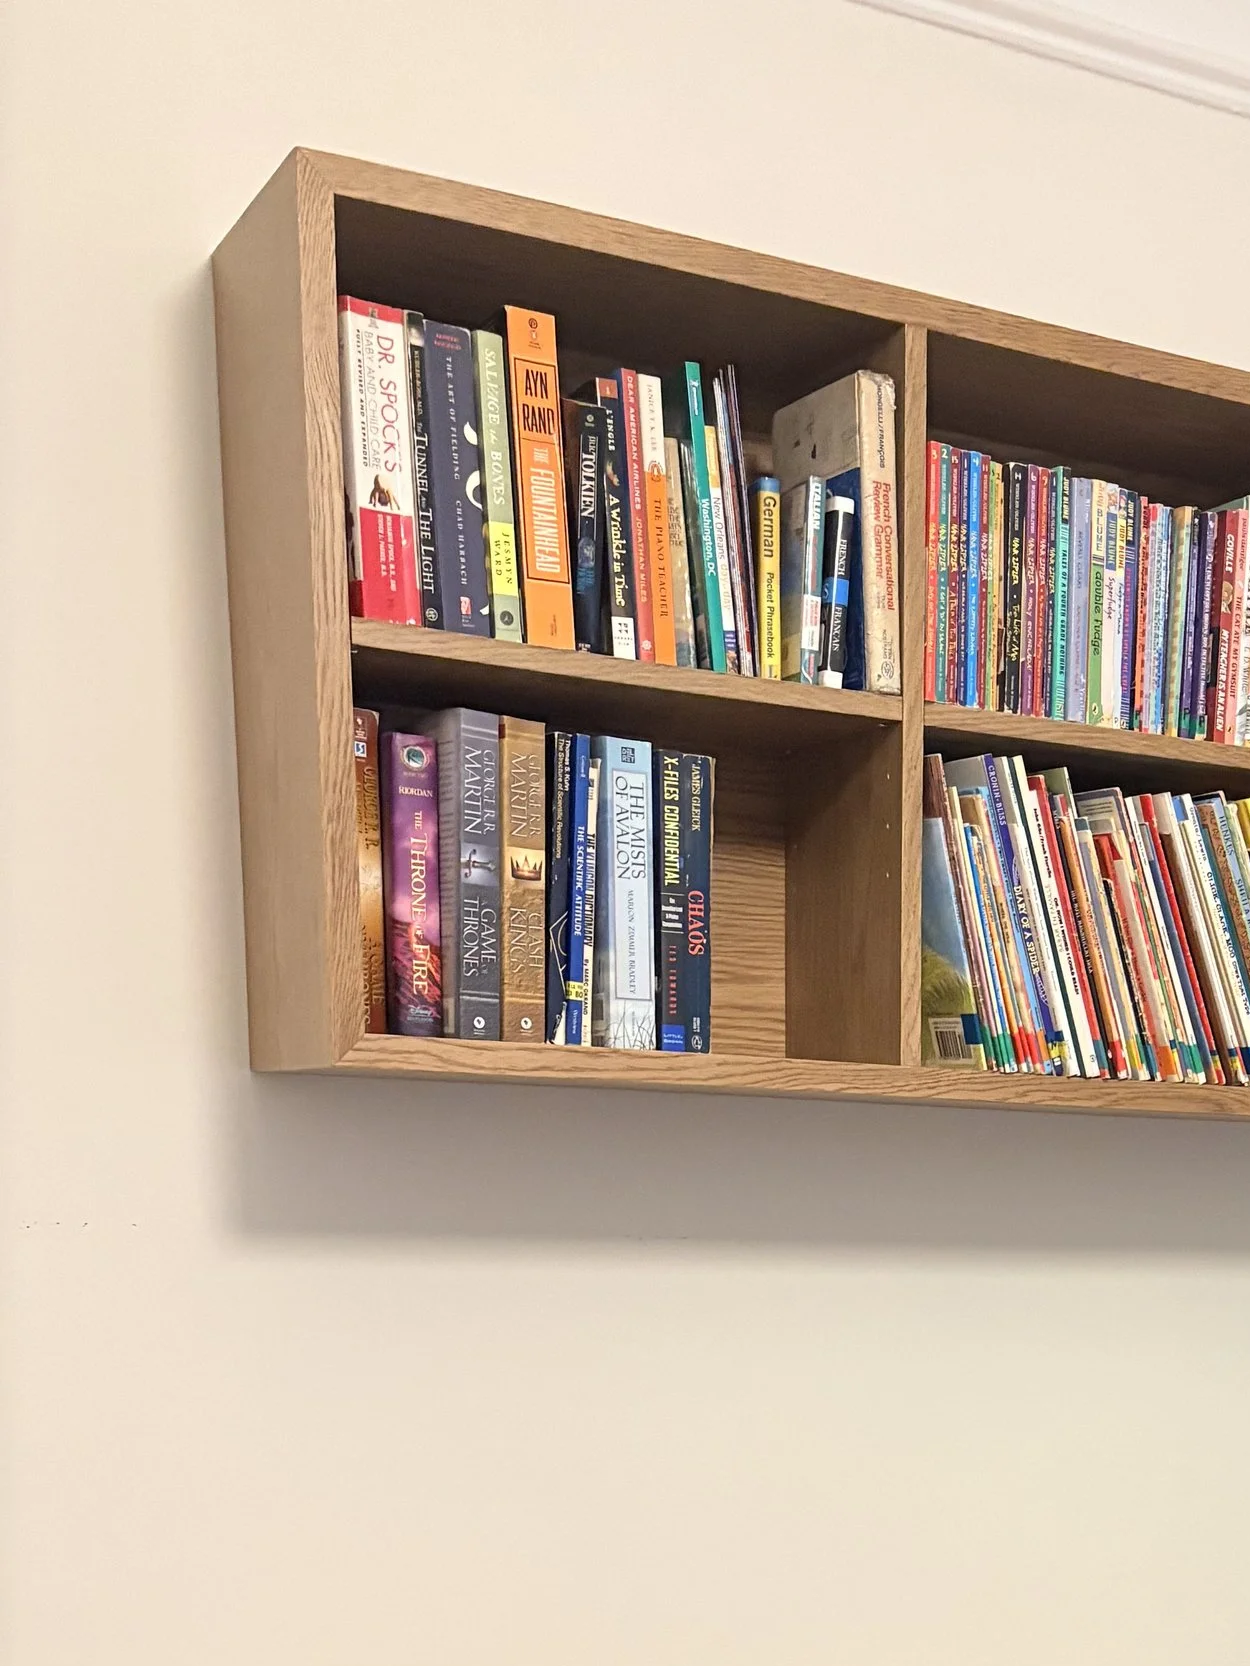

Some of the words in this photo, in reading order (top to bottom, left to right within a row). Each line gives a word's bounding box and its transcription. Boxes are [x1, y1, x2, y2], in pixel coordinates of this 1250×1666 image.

[364, 331, 374, 361] BABY
[377, 335, 395, 369] DR.
[366, 367, 377, 395] AND
[525, 369, 549, 399] AYN
[627, 375, 635, 404] DEAR
[369, 399, 380, 436] CHILD
[450, 409, 457, 422] OF
[522, 403, 555, 435] RAND
[606, 409, 616, 451] L'ENGLE
[629, 406, 639, 459] AMERICAN
[370, 439, 382, 470] CARE
[451, 427, 460, 480] FIELDING
[533, 447, 549, 464] THE
[941, 449, 948, 458] 2
[633, 463, 642, 510] AIRLINES
[1030, 472, 1037, 482] 6
[609, 493, 621, 506] A
[654, 500, 662, 520] THE
[814, 482, 822, 530] ITALIAN
[872, 481, 882, 523] Review
[882, 483, 891, 523] French
[1127, 500, 1135, 518] JUDY
[530, 468, 561, 573] FOUNTAINHEAD
[610, 508, 627, 561] Wrinkle
[701, 498, 714, 560] Washington,
[763, 495, 777, 558] German
[458, 535, 467, 585] HARBACH
[495, 540, 503, 576] WARD
[636, 518, 645, 571] JONATHAN
[656, 526, 665, 561] PIANO
[838, 539, 848, 576] FRENCH
[874, 525, 884, 579] Grammar
[1108, 541, 1116, 565] BLUME
[1225, 533, 1235, 573] COVILLE
[613, 562, 621, 573] in
[707, 562, 717, 577] DC
[884, 524, 895, 611] Conversational
[1061, 572, 1067, 580] OF
[614, 575, 629, 607] Time
[640, 574, 648, 603] MILES
[658, 566, 669, 618] TEACHER
[765, 572, 775, 603] Pocket
[1094, 571, 1103, 614] double
[1104, 577, 1116, 620] Superfudge
[765, 606, 775, 658] Phrasebook
[1091, 619, 1103, 656] fudge
[1221, 629, 1230, 644] MY
[1219, 643, 1229, 680] TEACHER
[1217, 690, 1225, 705] AN
[1219, 681, 1226, 690] IS
[1216, 706, 1225, 732] ALIEN
[398, 785, 433, 798] RIORDAN
[464, 746, 483, 834] MARTIN
[511, 752, 529, 838] MARTIN
[615, 775, 628, 799] OF
[663, 756, 679, 801] X-FILES
[691, 763, 701, 796] JAMES
[988, 764, 1000, 796] CRONIN
[996, 801, 1007, 826] BLISS
[630, 783, 645, 820] THE
[691, 797, 701, 831] GLEICK
[576, 826, 585, 844] THE
[615, 804, 631, 880] AVALON
[630, 827, 646, 880] MISTS
[664, 806, 680, 886] CONFIDENTIAL
[575, 844, 585, 893] SCIENTIFIC
[1219, 815, 1234, 856] HENKES
[1235, 878, 1250, 916] SHEILA
[574, 895, 584, 936] ATTITUDE
[1013, 885, 1024, 914] DIARY
[462, 897, 480, 977] THRONES
[529, 912, 544, 968] CLASH
[687, 890, 705, 956] CHAOS
[1020, 915, 1028, 928] OF
[1024, 930, 1032, 939] A
[511, 907, 528, 974] KINGS
[1026, 941, 1041, 976] SPIDER
[628, 958, 636, 994] BRADLEY
